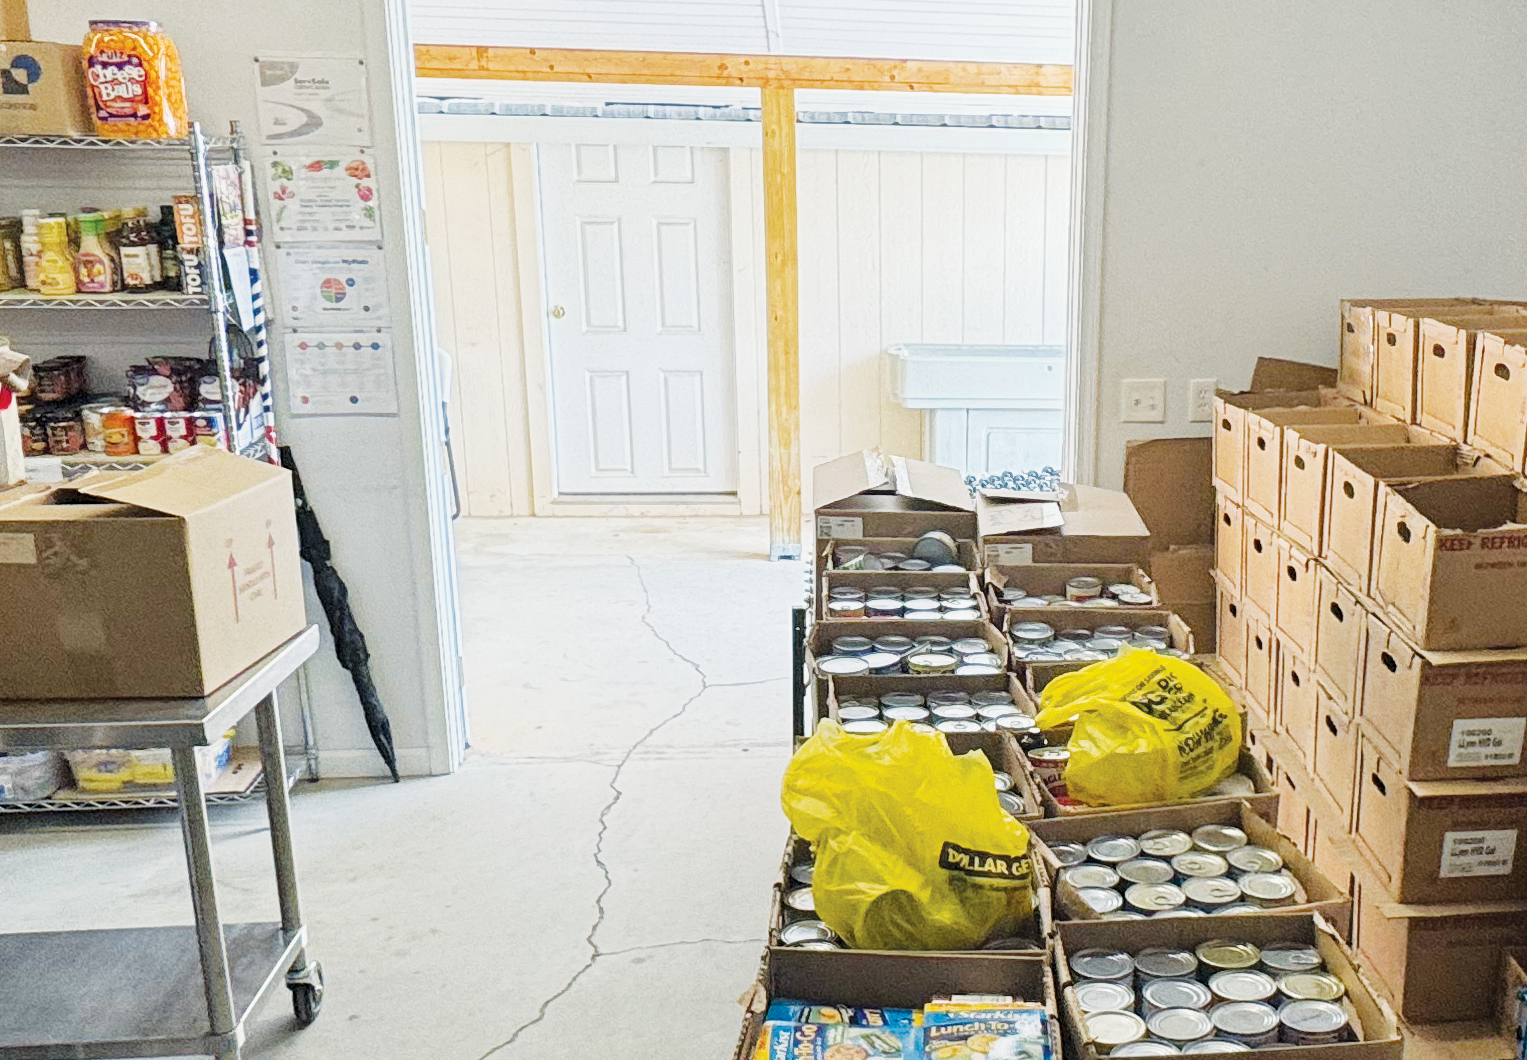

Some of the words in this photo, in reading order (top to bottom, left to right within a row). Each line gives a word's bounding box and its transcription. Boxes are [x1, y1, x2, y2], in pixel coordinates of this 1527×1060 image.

[88, 65, 146, 86] Cheese
[100, 81, 143, 100] Balls
[184, 203, 198, 244] TOFU
[186, 256, 201, 295] TOFU
[1438, 536, 1473, 551] KEEP
[947, 847, 1009, 875] DOLLAR
